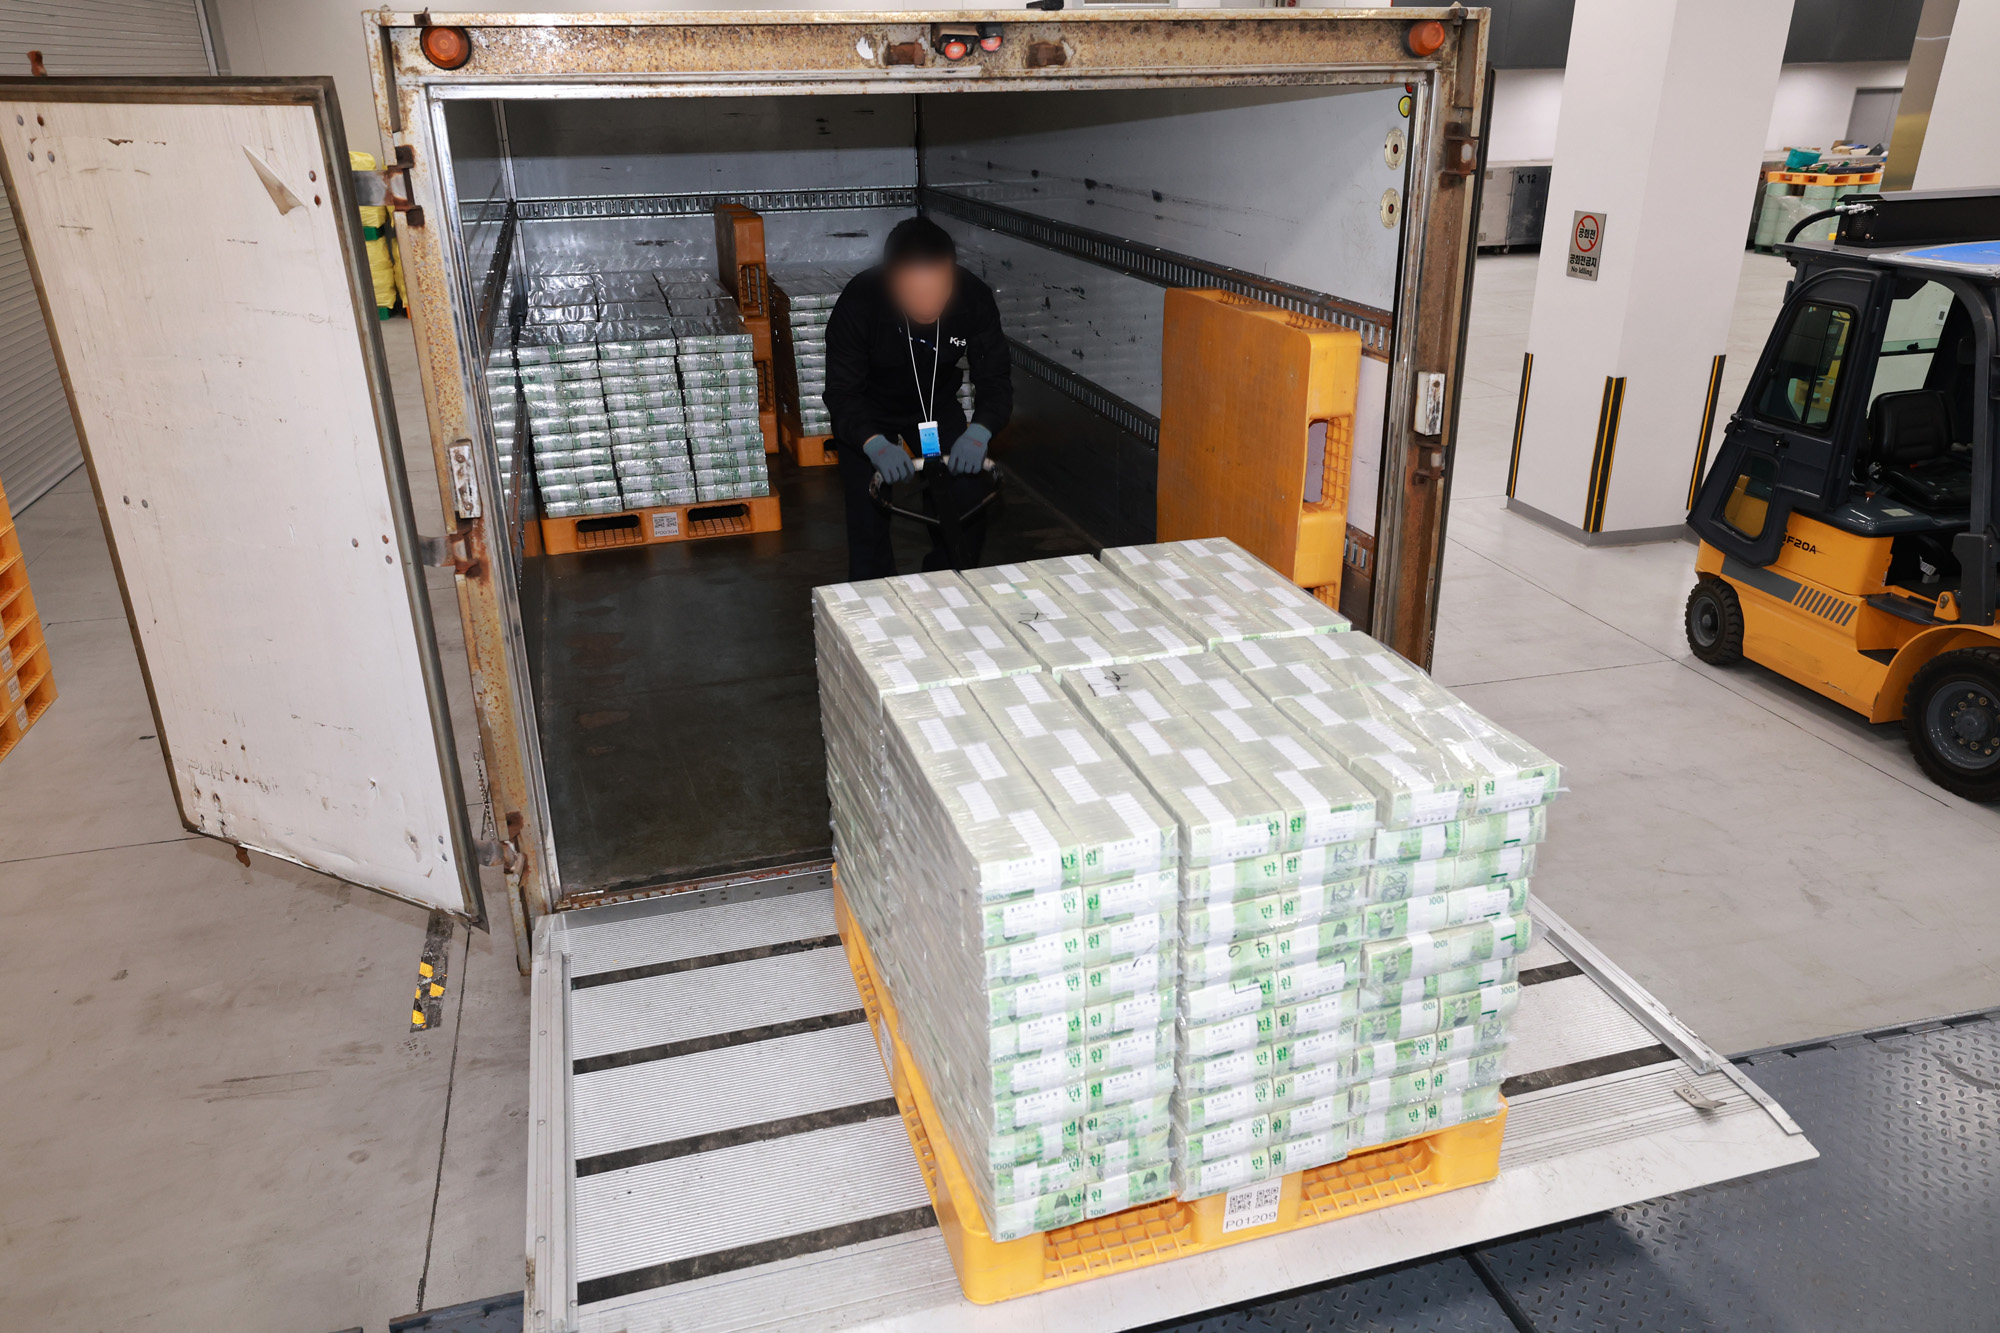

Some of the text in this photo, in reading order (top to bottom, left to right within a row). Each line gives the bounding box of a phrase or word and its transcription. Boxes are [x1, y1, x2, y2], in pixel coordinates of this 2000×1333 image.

[1578, 228, 1596, 240] 공회전
[1569, 254, 1597, 268] 공회전금지
[1464, 783, 1474, 799] 만
[1269, 820, 1280, 836] 만
[1061, 853, 1076, 869] 만
[1265, 861, 1277, 876] 만
[1063, 898, 1077, 914] 만
[1262, 904, 1274, 919] 만
[1064, 938, 1079, 953] 만
[1259, 943, 1271, 959] 만
[1067, 976, 1080, 991] 만
[1261, 979, 1273, 995] 만
[1068, 1016, 1081, 1032] 만
[1258, 1016, 1271, 1032] 만
[1419, 1042, 1431, 1056] 만
[1068, 1053, 1082, 1068] 만
[1256, 1051, 1269, 1066] 만
[1414, 1077, 1426, 1091] 만
[1068, 1087, 1081, 1102] 만
[1255, 1086, 1267, 1102] 만
[1409, 1109, 1420, 1123] 만
[1252, 1122, 1264, 1137] 만
[1068, 1158, 1080, 1172] 만
[1251, 1155, 1263, 1170] 만
[1070, 1193, 1082, 1208] 만
[1225, 1211, 1277, 1230] P01209
